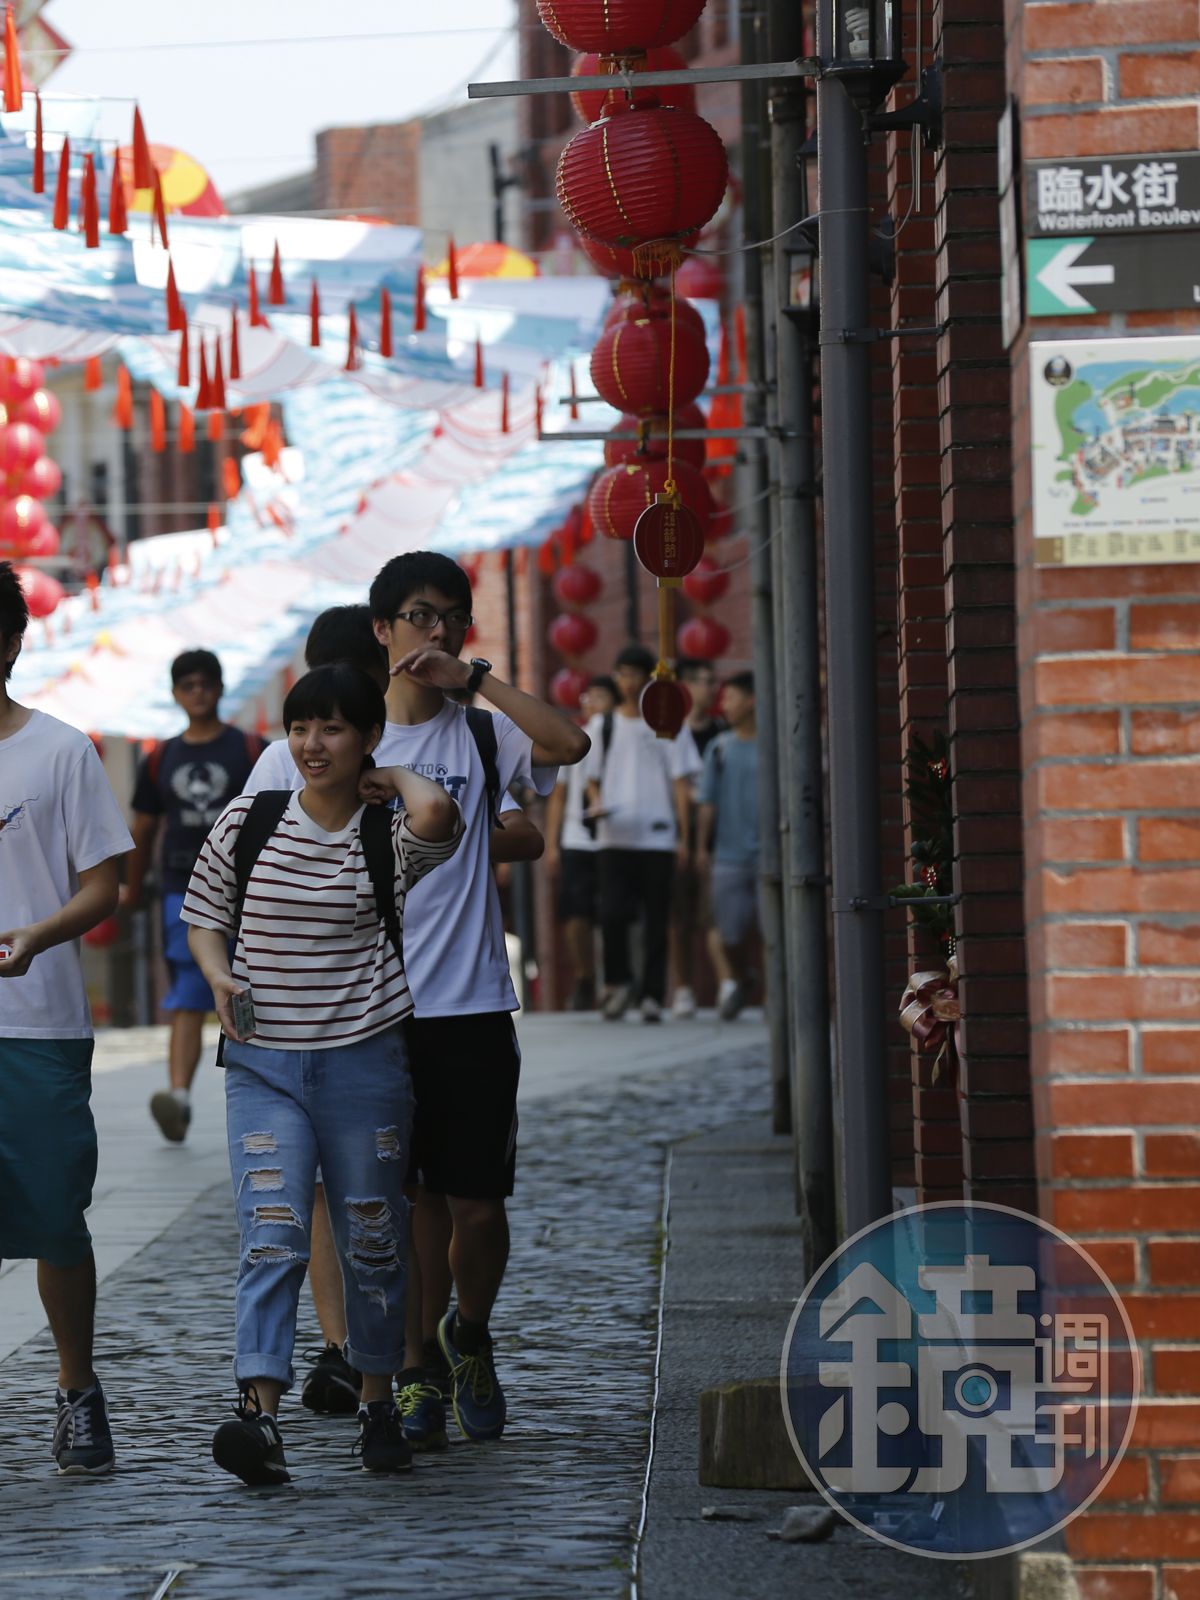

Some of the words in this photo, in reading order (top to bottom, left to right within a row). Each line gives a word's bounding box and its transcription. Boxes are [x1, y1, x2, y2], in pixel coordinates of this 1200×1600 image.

[1037, 162, 1178, 213] 臨水街
[1038, 210, 1135, 230] Waterfront
